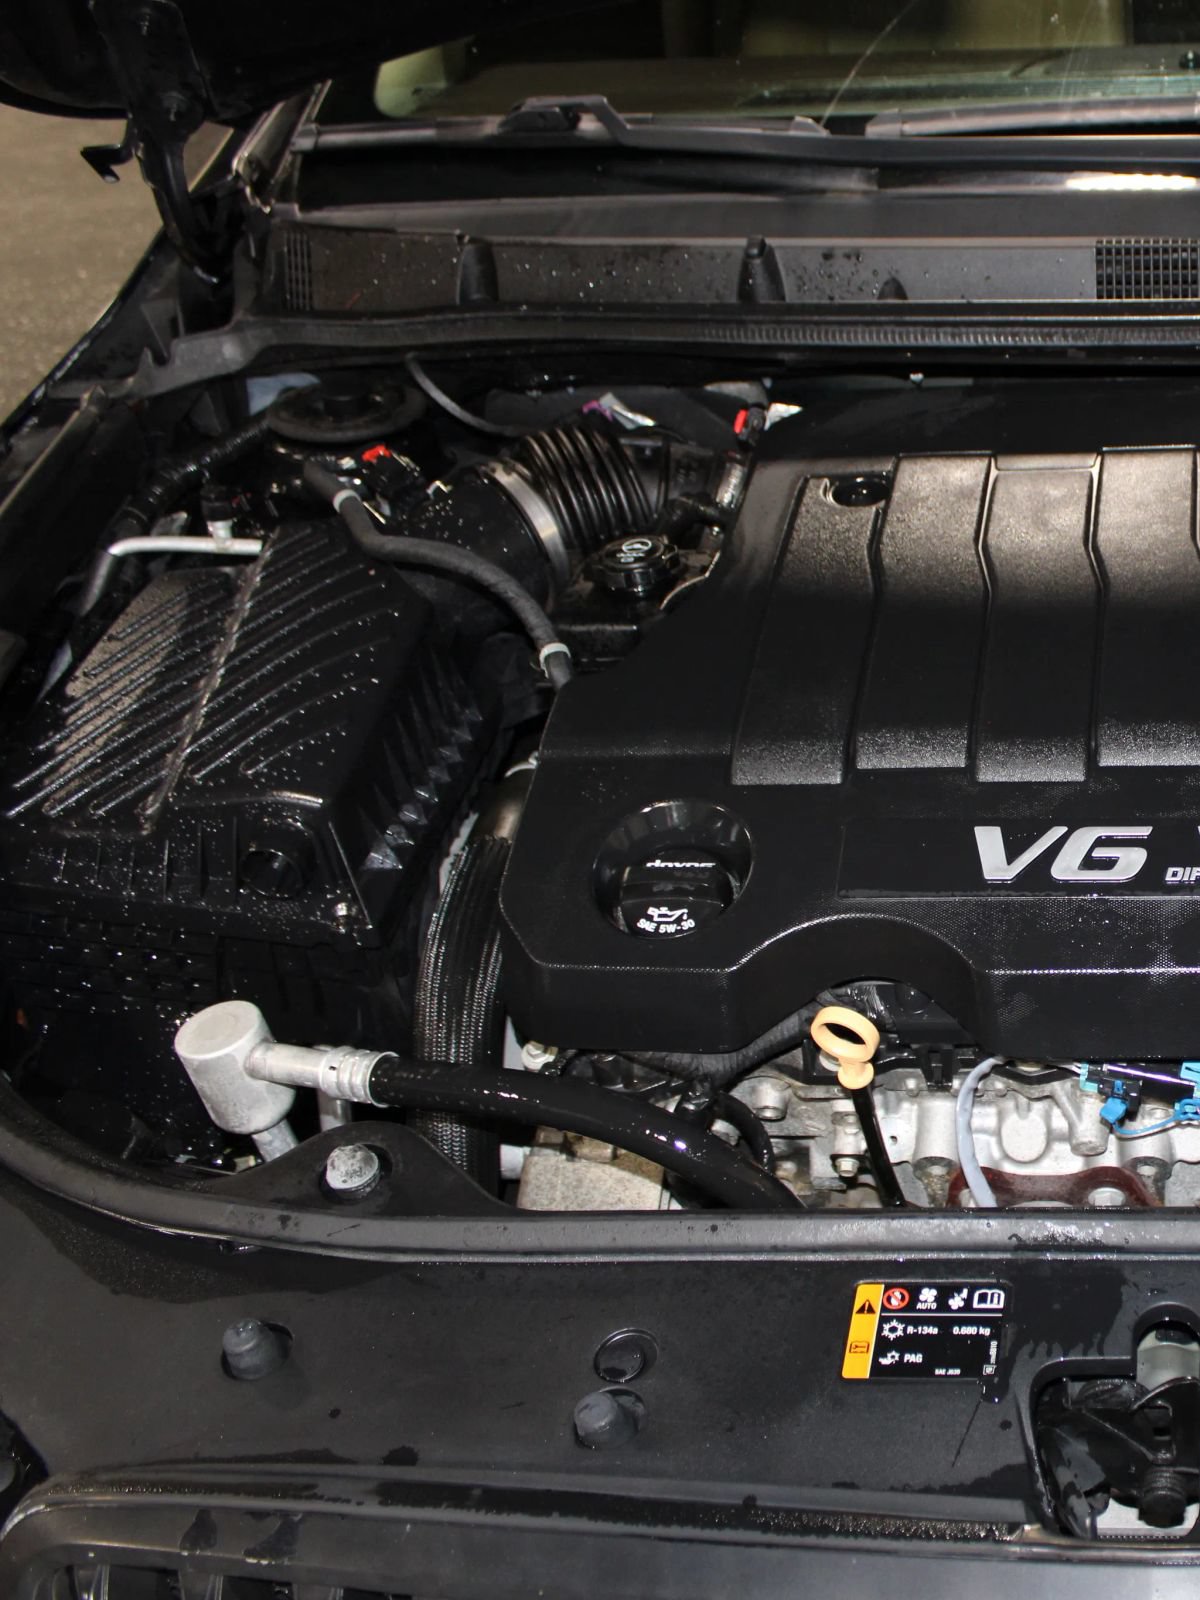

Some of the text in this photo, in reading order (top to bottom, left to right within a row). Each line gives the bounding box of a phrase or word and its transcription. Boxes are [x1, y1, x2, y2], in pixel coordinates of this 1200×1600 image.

[974, 825, 1153, 884] V6
[637, 918, 695, 933] SAE 5W-30
[916, 1302, 937, 1310] AUTO
[906, 1326, 938, 1335] R-134a
[978, 1326, 991, 1337] kg
[903, 1353, 923, 1363] PAG
